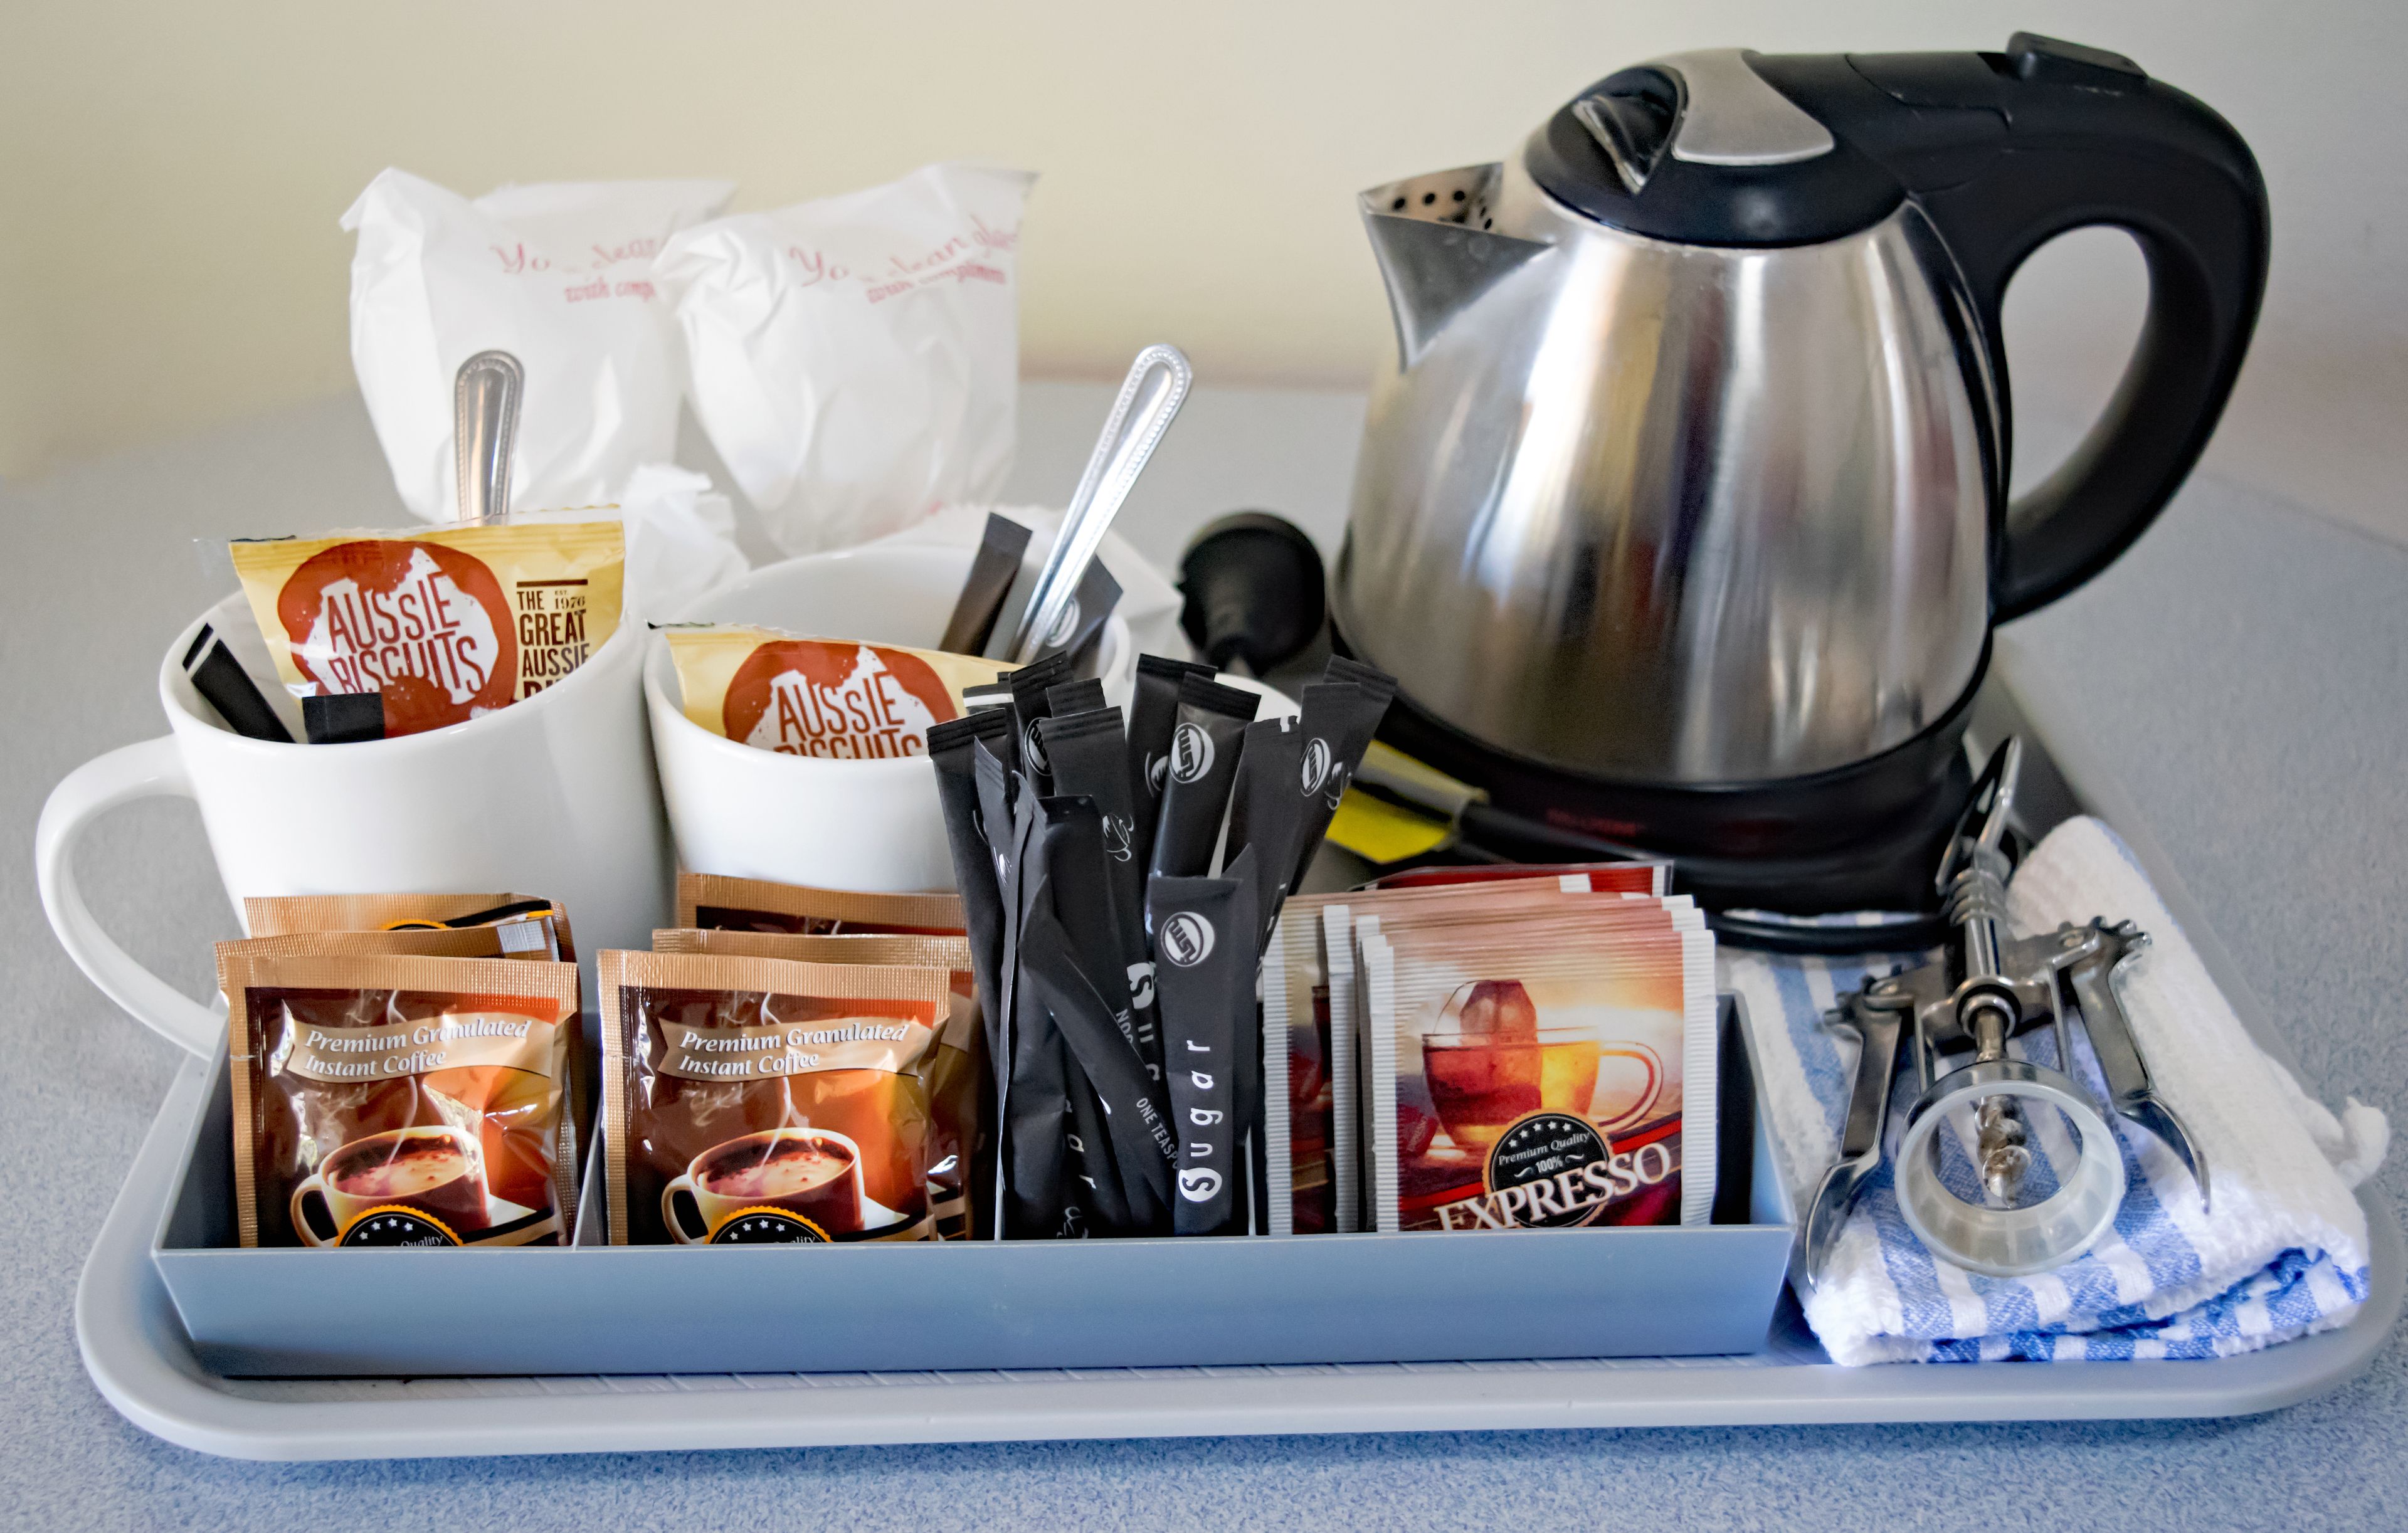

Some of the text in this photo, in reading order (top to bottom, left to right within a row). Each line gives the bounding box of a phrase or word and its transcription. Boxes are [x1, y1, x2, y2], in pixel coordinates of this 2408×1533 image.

[327, 571, 461, 653] AUSSIE
[517, 591, 544, 610] THE
[555, 596, 586, 609] 1976
[519, 609, 586, 646] GREAT
[522, 643, 590, 678] AUSSIE
[777, 671, 905, 742] AUSSIE
[305, 1018, 532, 1053] Premium Granulated
[679, 1023, 909, 1053] Premium Granulated
[304, 1050, 447, 1077] Instant Coffee
[679, 1051, 820, 1076] Instant Coffee
[1136, 1097, 1158, 1124] ONE
[1179, 1040, 1223, 1202] Sugar
[1498, 1132, 1591, 1166] Premium Quality
[1535, 1154, 1564, 1174] 100%
[1434, 1142, 1672, 1230] EXPRESSO
